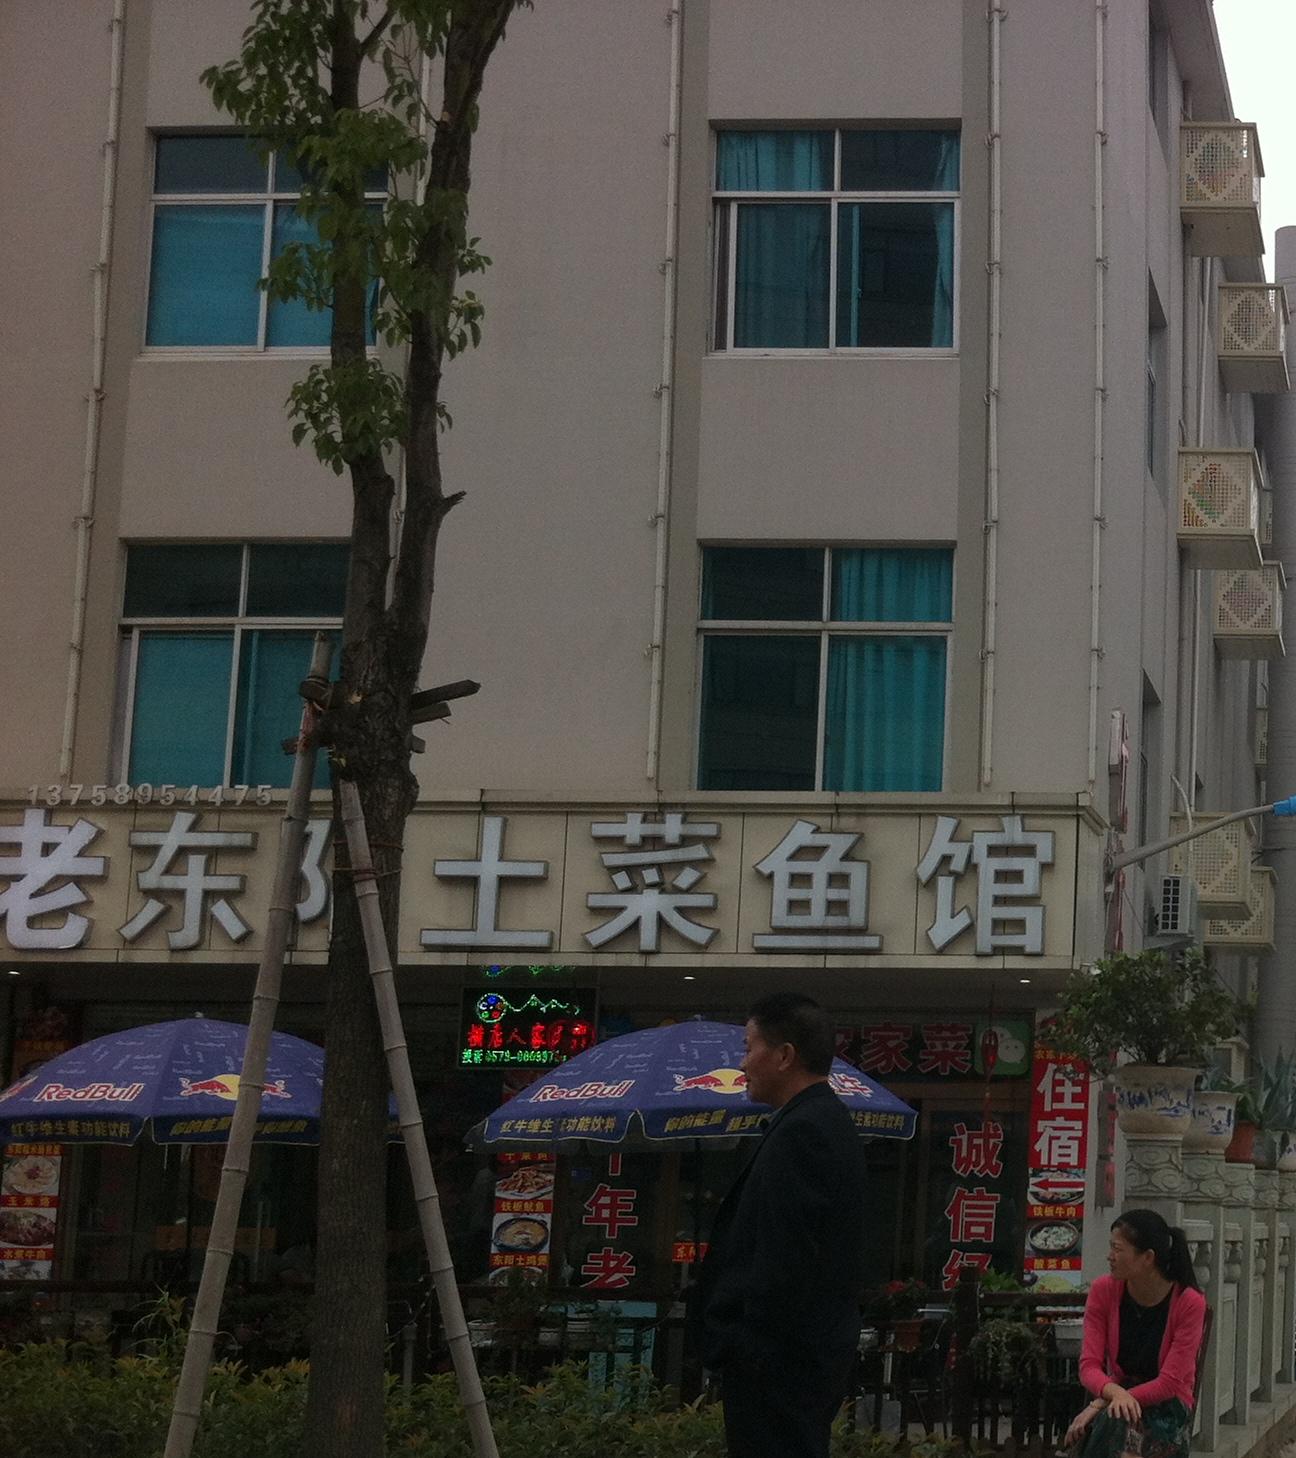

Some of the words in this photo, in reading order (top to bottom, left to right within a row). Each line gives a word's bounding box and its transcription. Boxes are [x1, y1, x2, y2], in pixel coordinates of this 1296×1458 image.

[27, 783, 273, 806] 13758954475
[33, 1083, 146, 1102] RedBull
[530, 1080, 636, 1102] RedBull
[1034, 1063, 1085, 1167] 住宿
